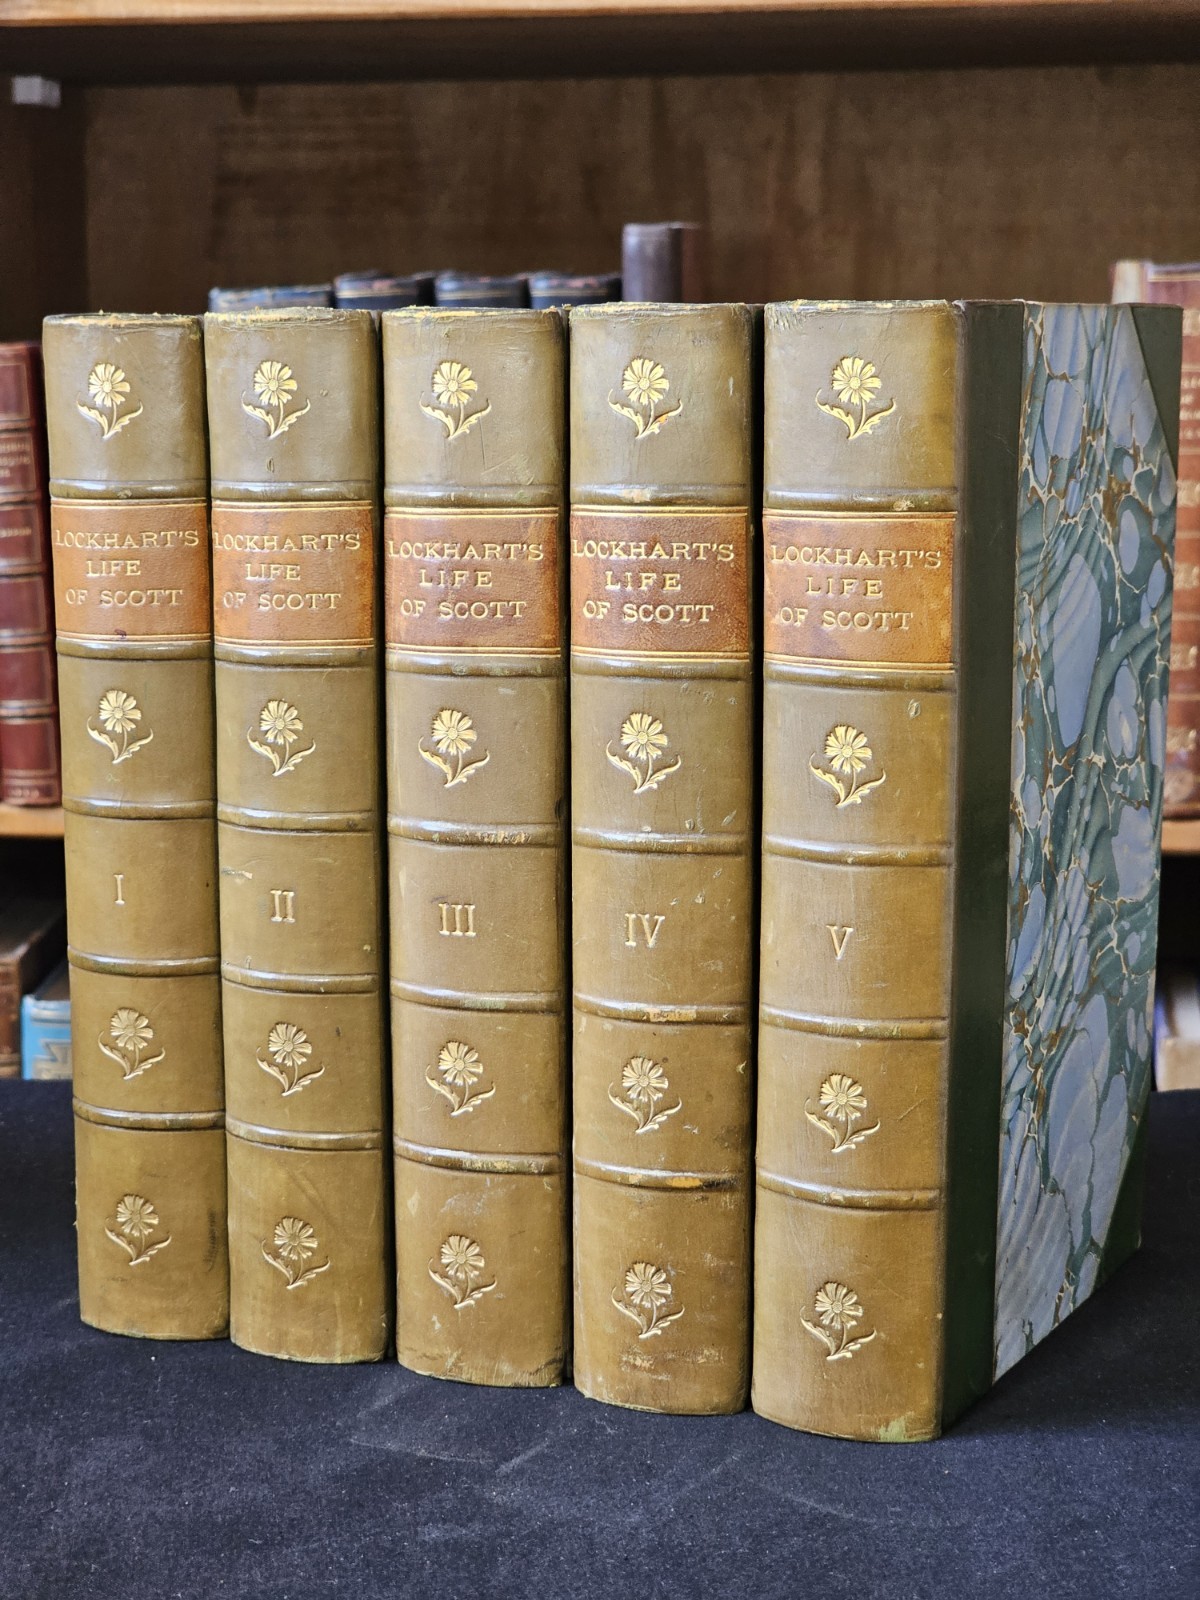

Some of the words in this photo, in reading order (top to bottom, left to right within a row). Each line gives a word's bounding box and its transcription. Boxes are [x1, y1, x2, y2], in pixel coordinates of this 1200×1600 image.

[55, 529, 200, 551] LOCKHART'S
[213, 532, 361, 554] LOCKHART'S
[388, 540, 544, 561] LOCKHART'S
[572, 540, 735, 562] LOCKHART'S
[770, 545, 941, 569] LOCKHART'S
[86, 560, 141, 578] LIFE
[245, 563, 301, 581] LIFE
[419, 569, 493, 588] LIFE
[604, 571, 682, 591] LIFE
[806, 576, 884, 598] LIFE
[65, 590, 87, 606] OF
[100, 589, 183, 606] SCOTT
[223, 592, 247, 609] OF
[258, 593, 341, 611] SCOTT
[400, 599, 426, 618] OF
[438, 601, 527, 619] SCOTT
[583, 600, 611, 619] OF
[623, 603, 714, 622] SCOTT
[779, 607, 809, 626] OF
[822, 610, 914, 632] SCOTT
[114, 874, 125, 905] I
[270, 889, 296, 923] II
[438, 903, 476, 937] III
[625, 913, 665, 947] IV
[826, 925, 854, 960] V
